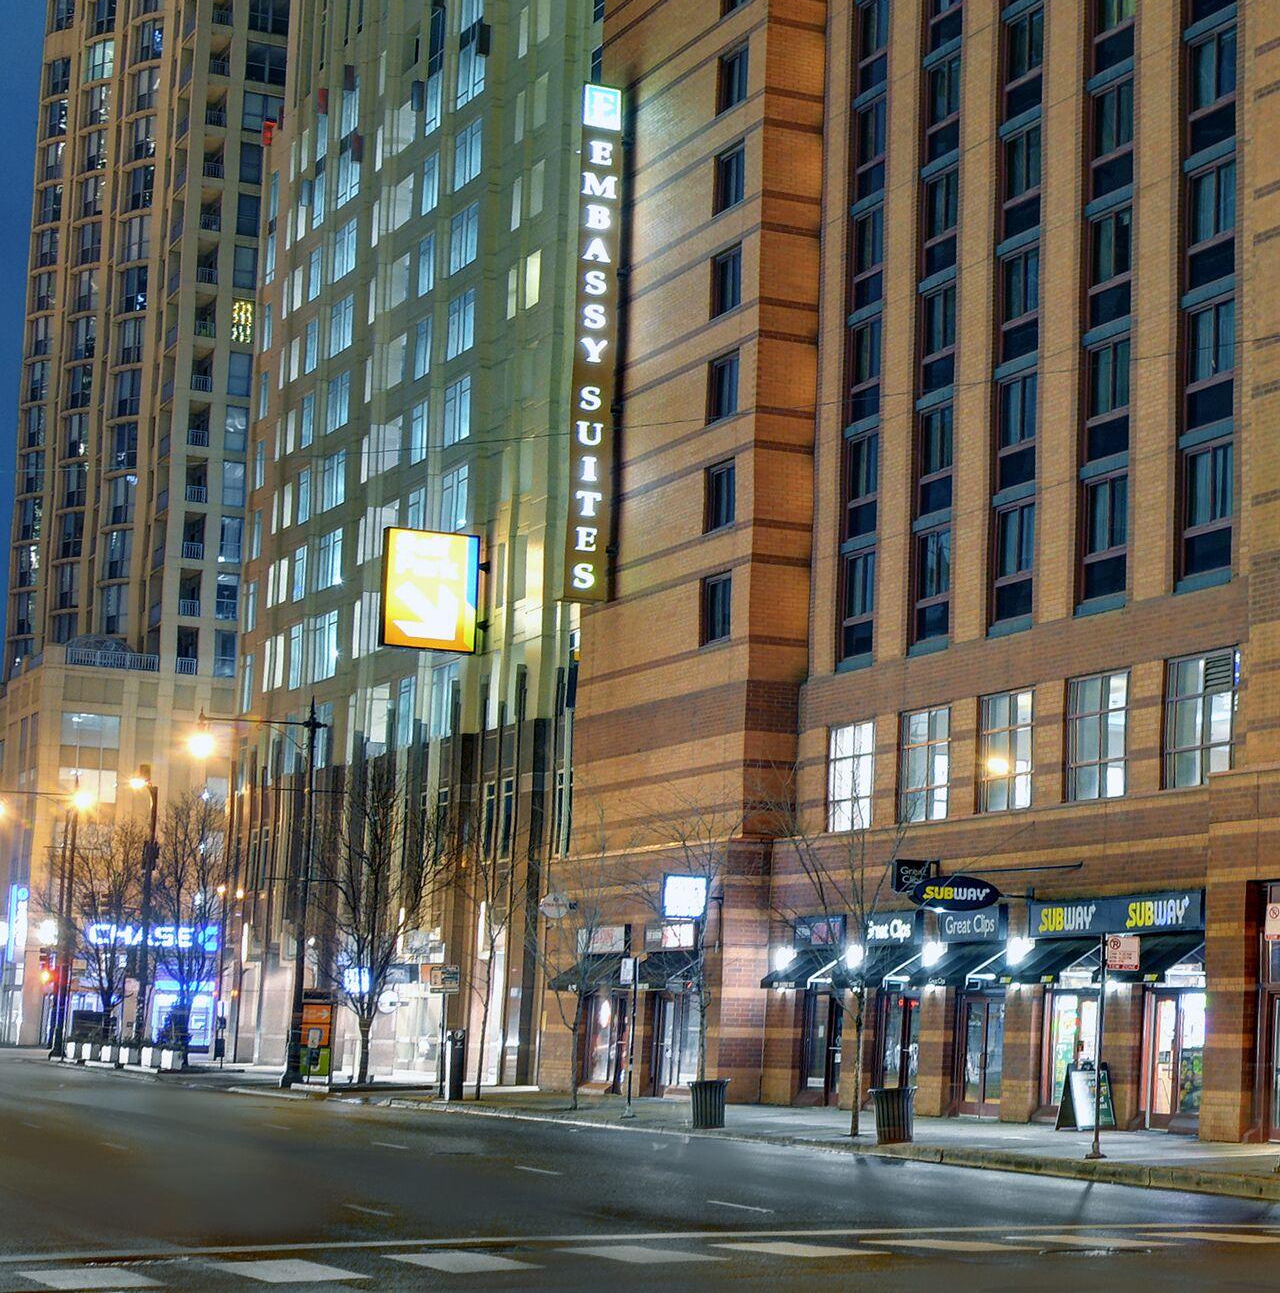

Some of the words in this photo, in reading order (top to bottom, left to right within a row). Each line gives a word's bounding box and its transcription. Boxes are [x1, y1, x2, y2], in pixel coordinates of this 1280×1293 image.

[580, 140, 618, 363] EMBASSY
[573, 386, 604, 589] SUITES
[922, 885, 990, 902] SUBWAY
[945, 916, 971, 935] Great
[973, 914, 995, 938] Clips
[1039, 901, 1096, 933] SUBWAY
[1125, 895, 1190, 929] SUBWAY
[88, 922, 195, 949] CHASE
[889, 919, 911, 943] Clips
